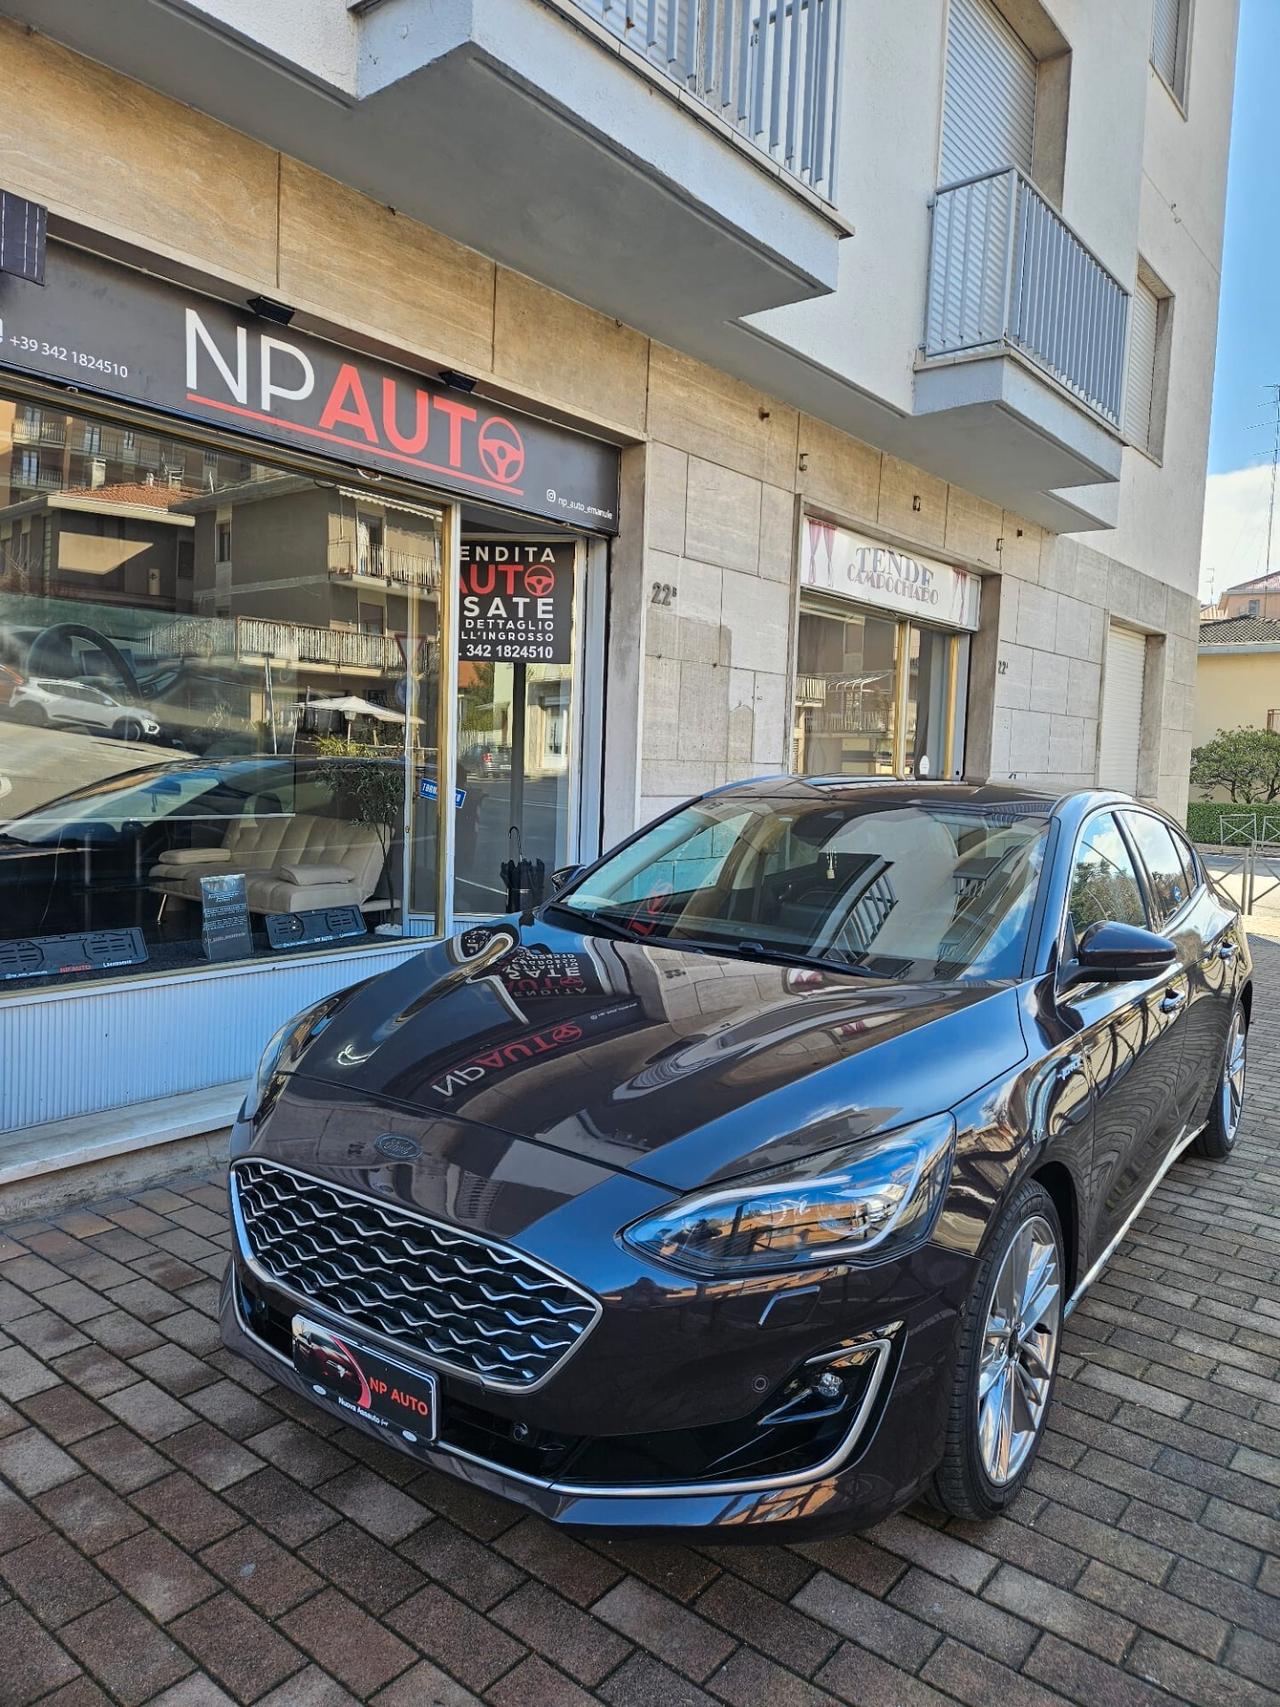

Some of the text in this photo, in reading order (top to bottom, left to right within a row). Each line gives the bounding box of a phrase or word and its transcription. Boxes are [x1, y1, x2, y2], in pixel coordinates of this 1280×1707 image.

[10, 336, 128, 378] +39 342 1824510
[185, 307, 315, 412] NP
[459, 546, 556, 563] ENDITA
[856, 547, 934, 587] TENDE
[463, 596, 554, 619] SATE
[461, 631, 554, 642] LL'INGROSSO
[465, 619, 554, 631] DETTAGLIO
[466, 644, 553, 659] 342 1824510
[369, 1377, 428, 1416] NP AUTO
